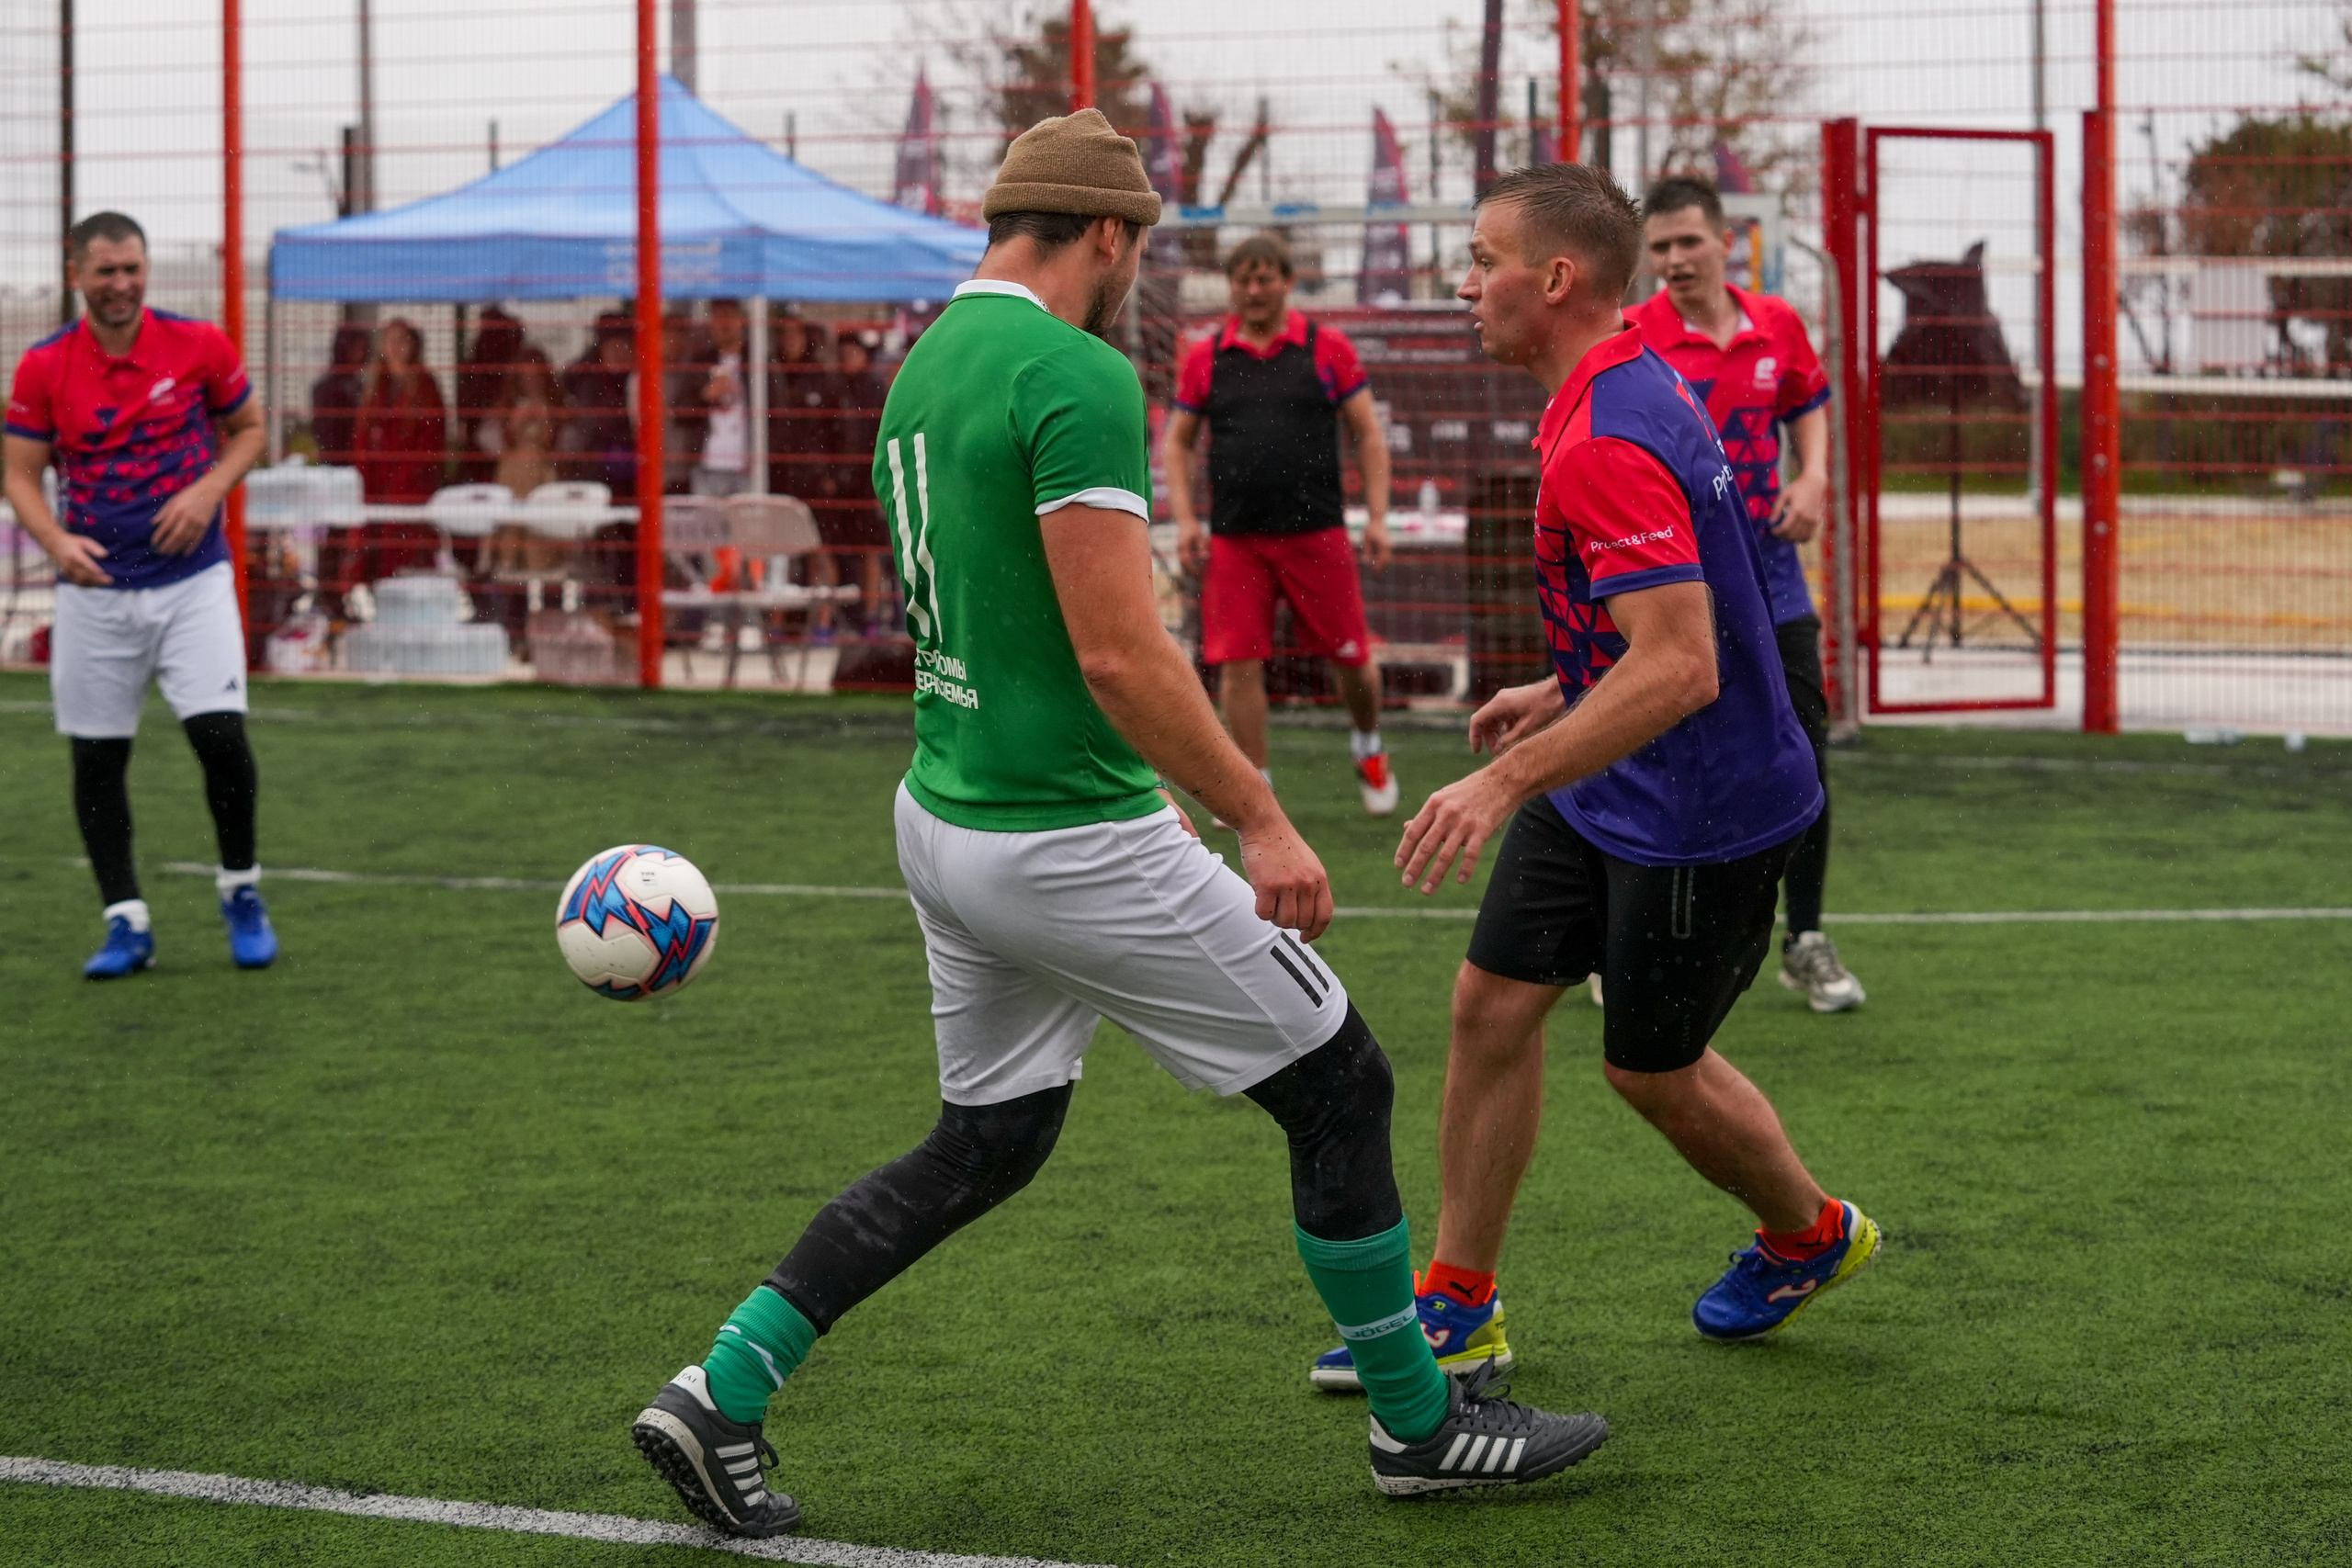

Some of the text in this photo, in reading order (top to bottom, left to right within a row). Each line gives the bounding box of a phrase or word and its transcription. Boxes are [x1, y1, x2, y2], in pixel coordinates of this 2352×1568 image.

[887, 432, 943, 644] 11
[1270, 931, 1330, 1009] 11
[1351, 1314, 1413, 1338] JÖGEL
